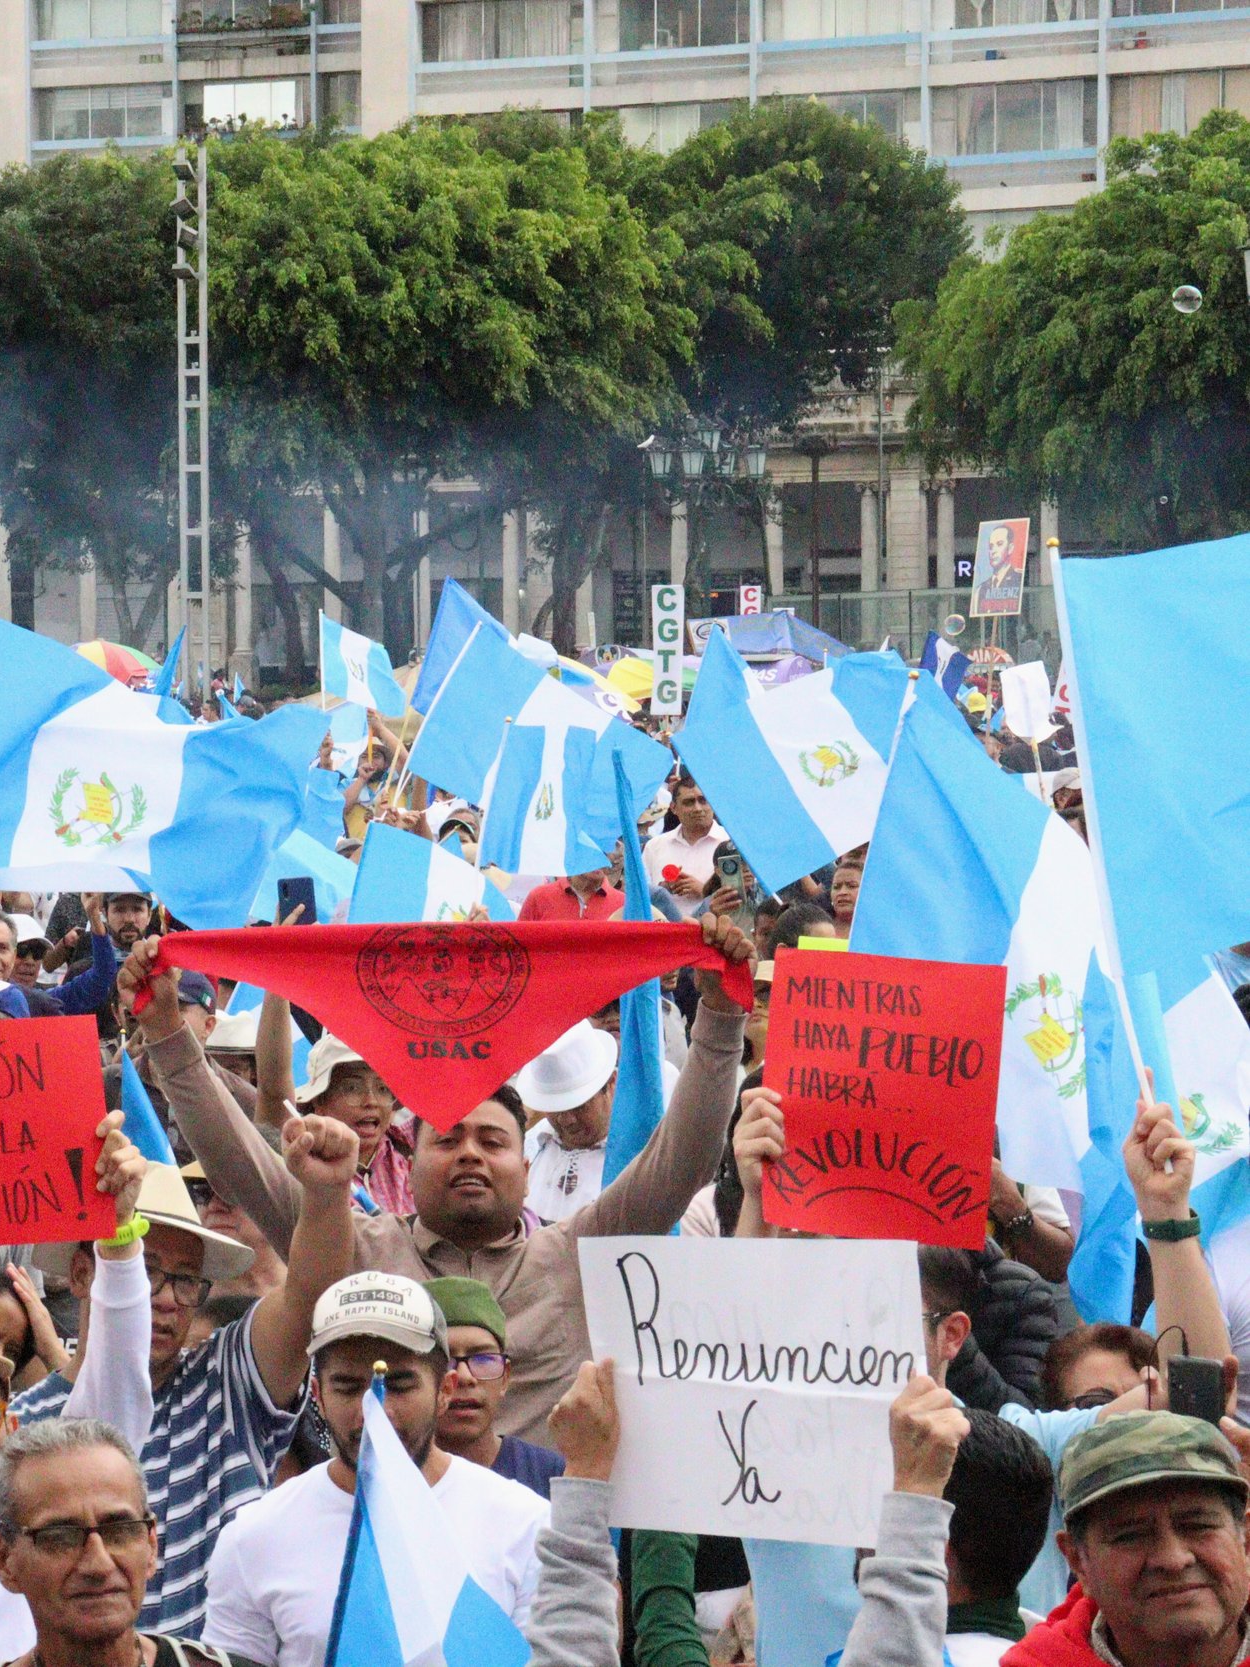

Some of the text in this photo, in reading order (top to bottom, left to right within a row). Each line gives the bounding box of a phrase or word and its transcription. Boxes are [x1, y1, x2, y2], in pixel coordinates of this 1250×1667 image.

[656, 587, 679, 704] CGTG
[786, 975, 923, 1017] MIENTRAS
[407, 1040, 492, 1060] USAC
[793, 1019, 853, 1051] HAYA
[858, 1025, 985, 1089] PUEBLO
[0, 1120, 38, 1154] LA
[767, 1128, 987, 1221] REVOLUCIÓN
[324, 1305, 420, 1326] ONE HAPPY ISLAND
[341, 1290, 402, 1304] EST. 1499
[616, 1252, 915, 1386] Renuncien
[717, 1400, 782, 1505] Ya
